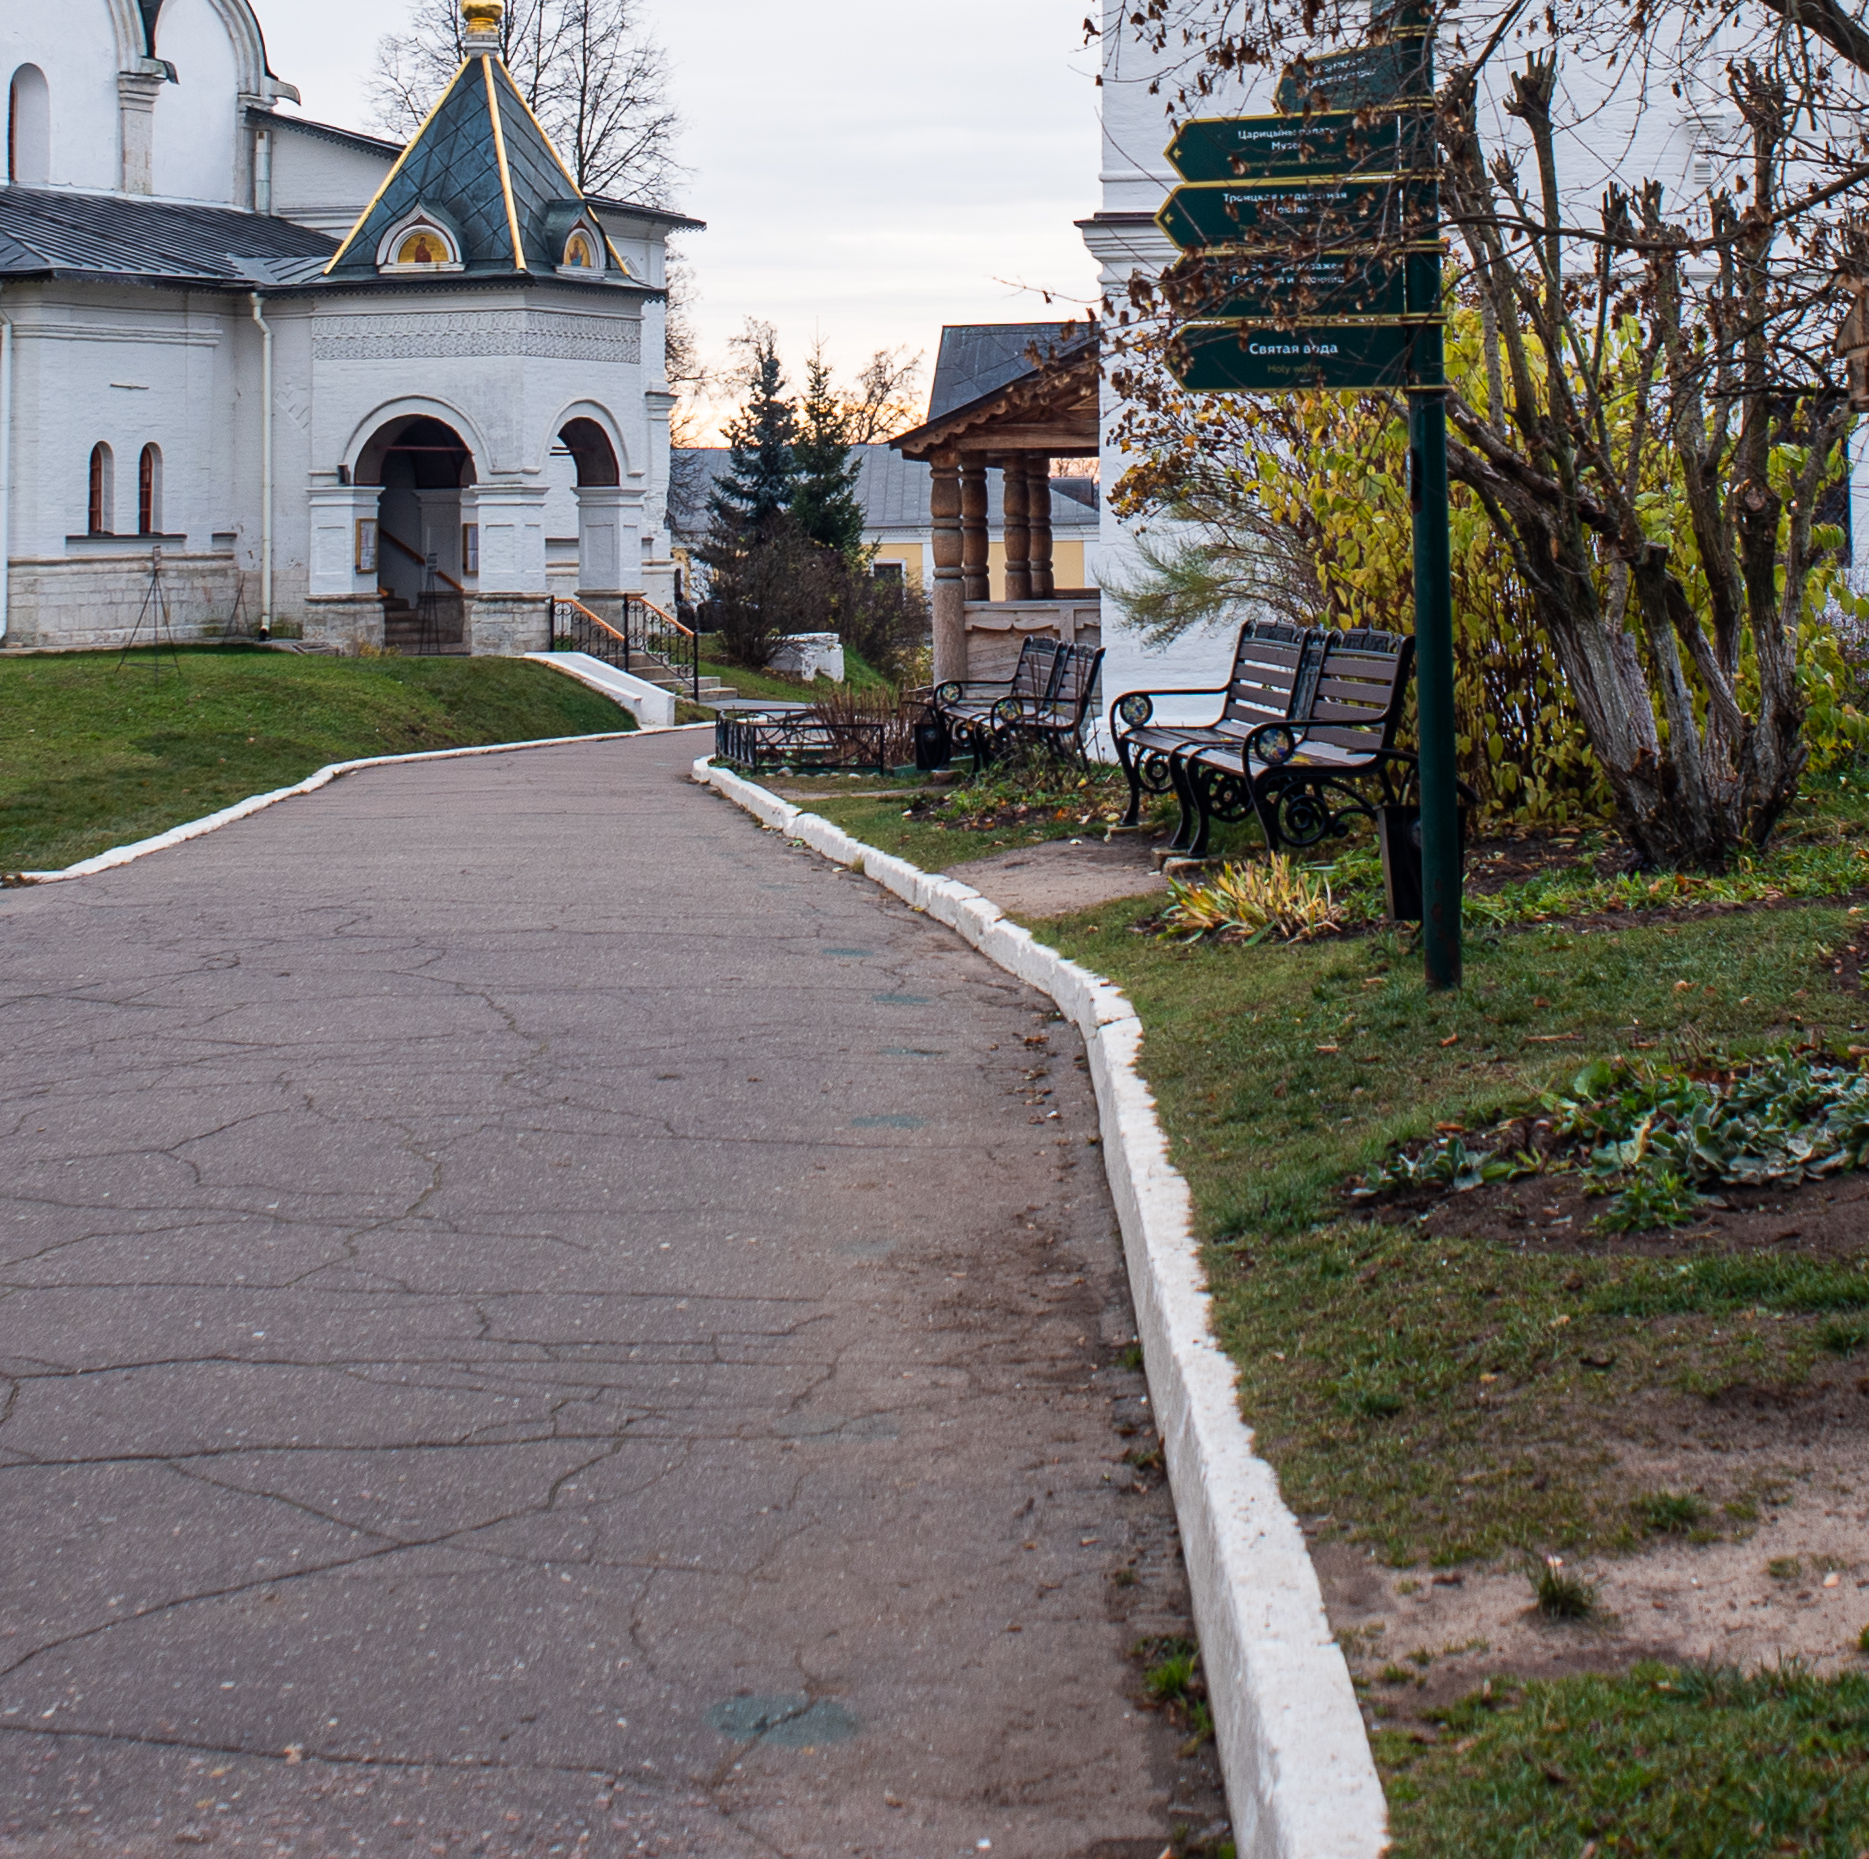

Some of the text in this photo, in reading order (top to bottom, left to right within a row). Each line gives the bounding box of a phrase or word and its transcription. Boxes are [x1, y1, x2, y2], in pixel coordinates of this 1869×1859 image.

[1249, 343, 1339, 355] Святая вода
[1267, 364, 1291, 375] Holy
